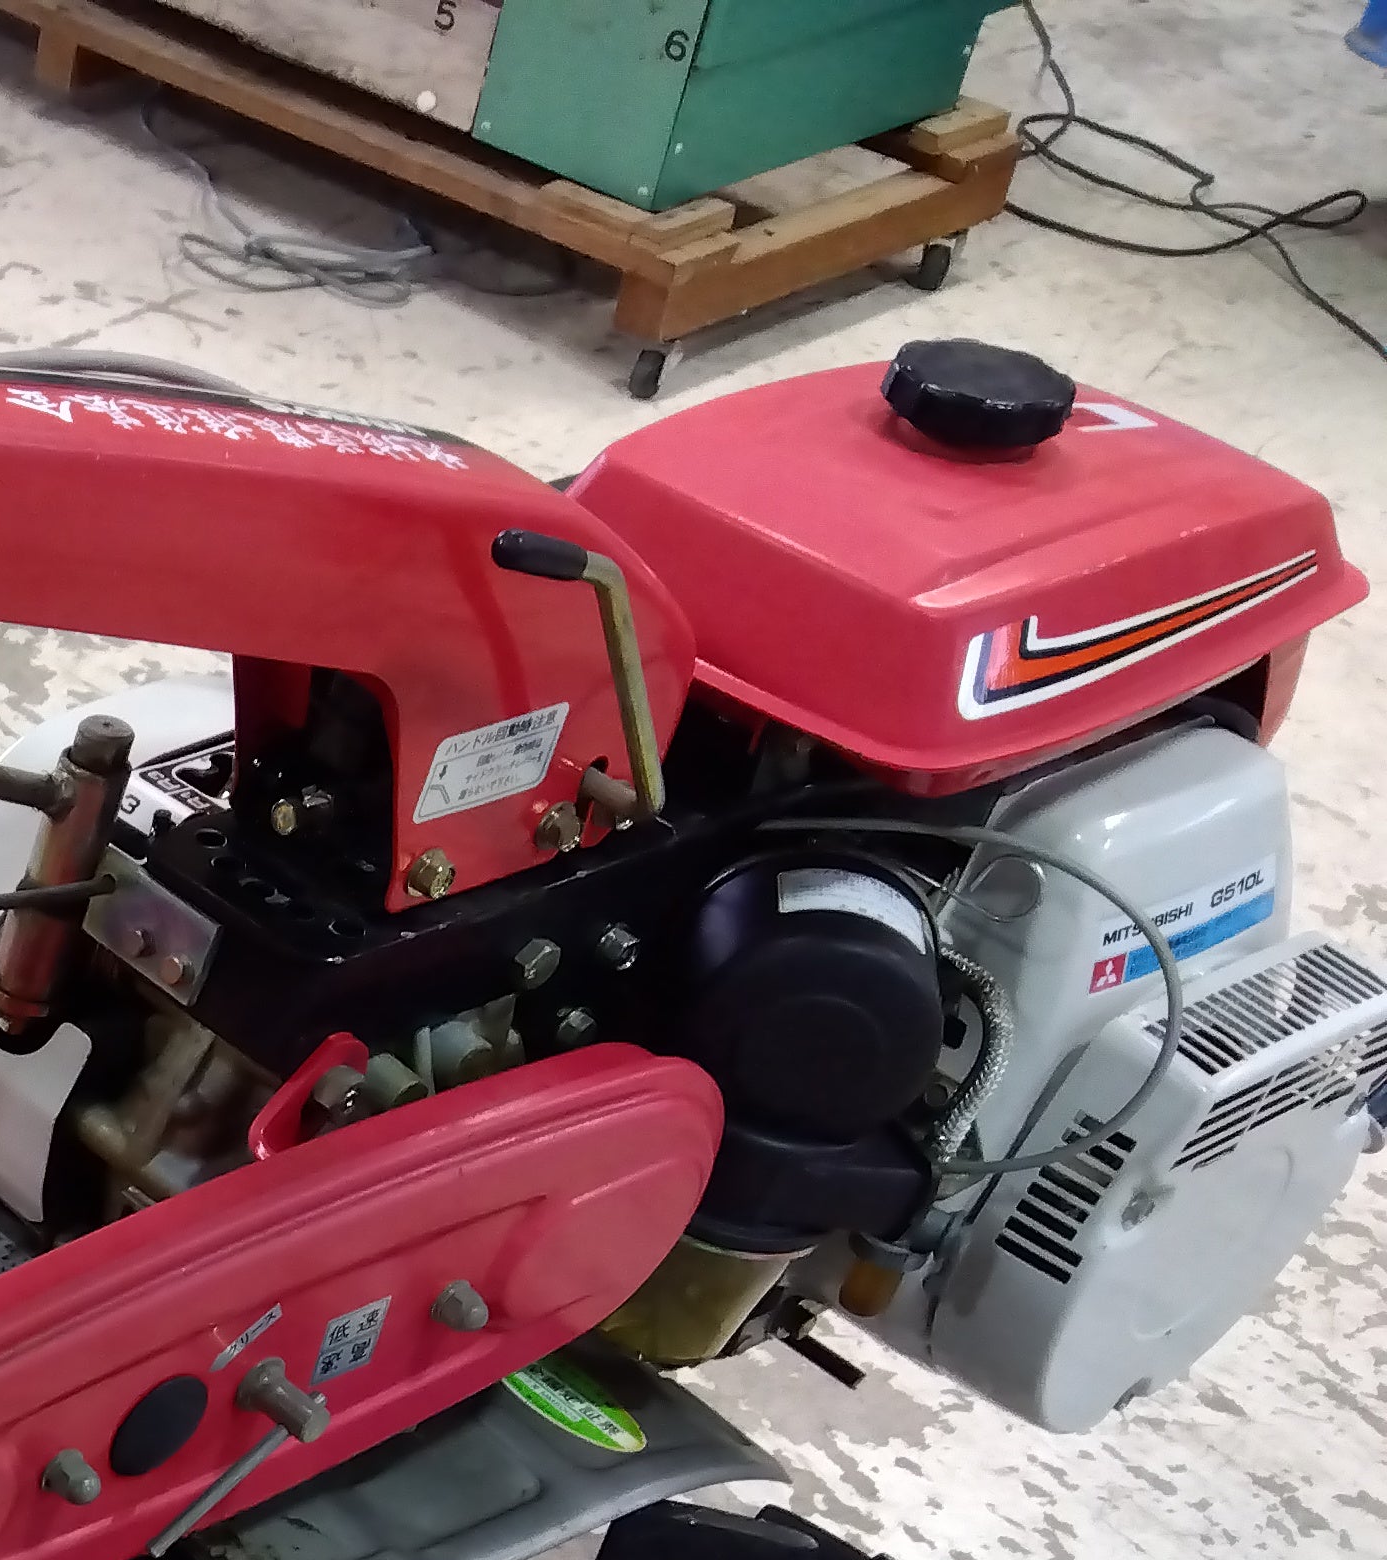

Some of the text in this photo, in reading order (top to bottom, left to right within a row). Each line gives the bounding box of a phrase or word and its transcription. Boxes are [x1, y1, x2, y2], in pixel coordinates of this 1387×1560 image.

[434, 0, 457, 31] 5
[664, 29, 690, 62] 6
[1102, 870, 1265, 946] MITSBISHI G510L
[328, 1308, 381, 1346] 低速
